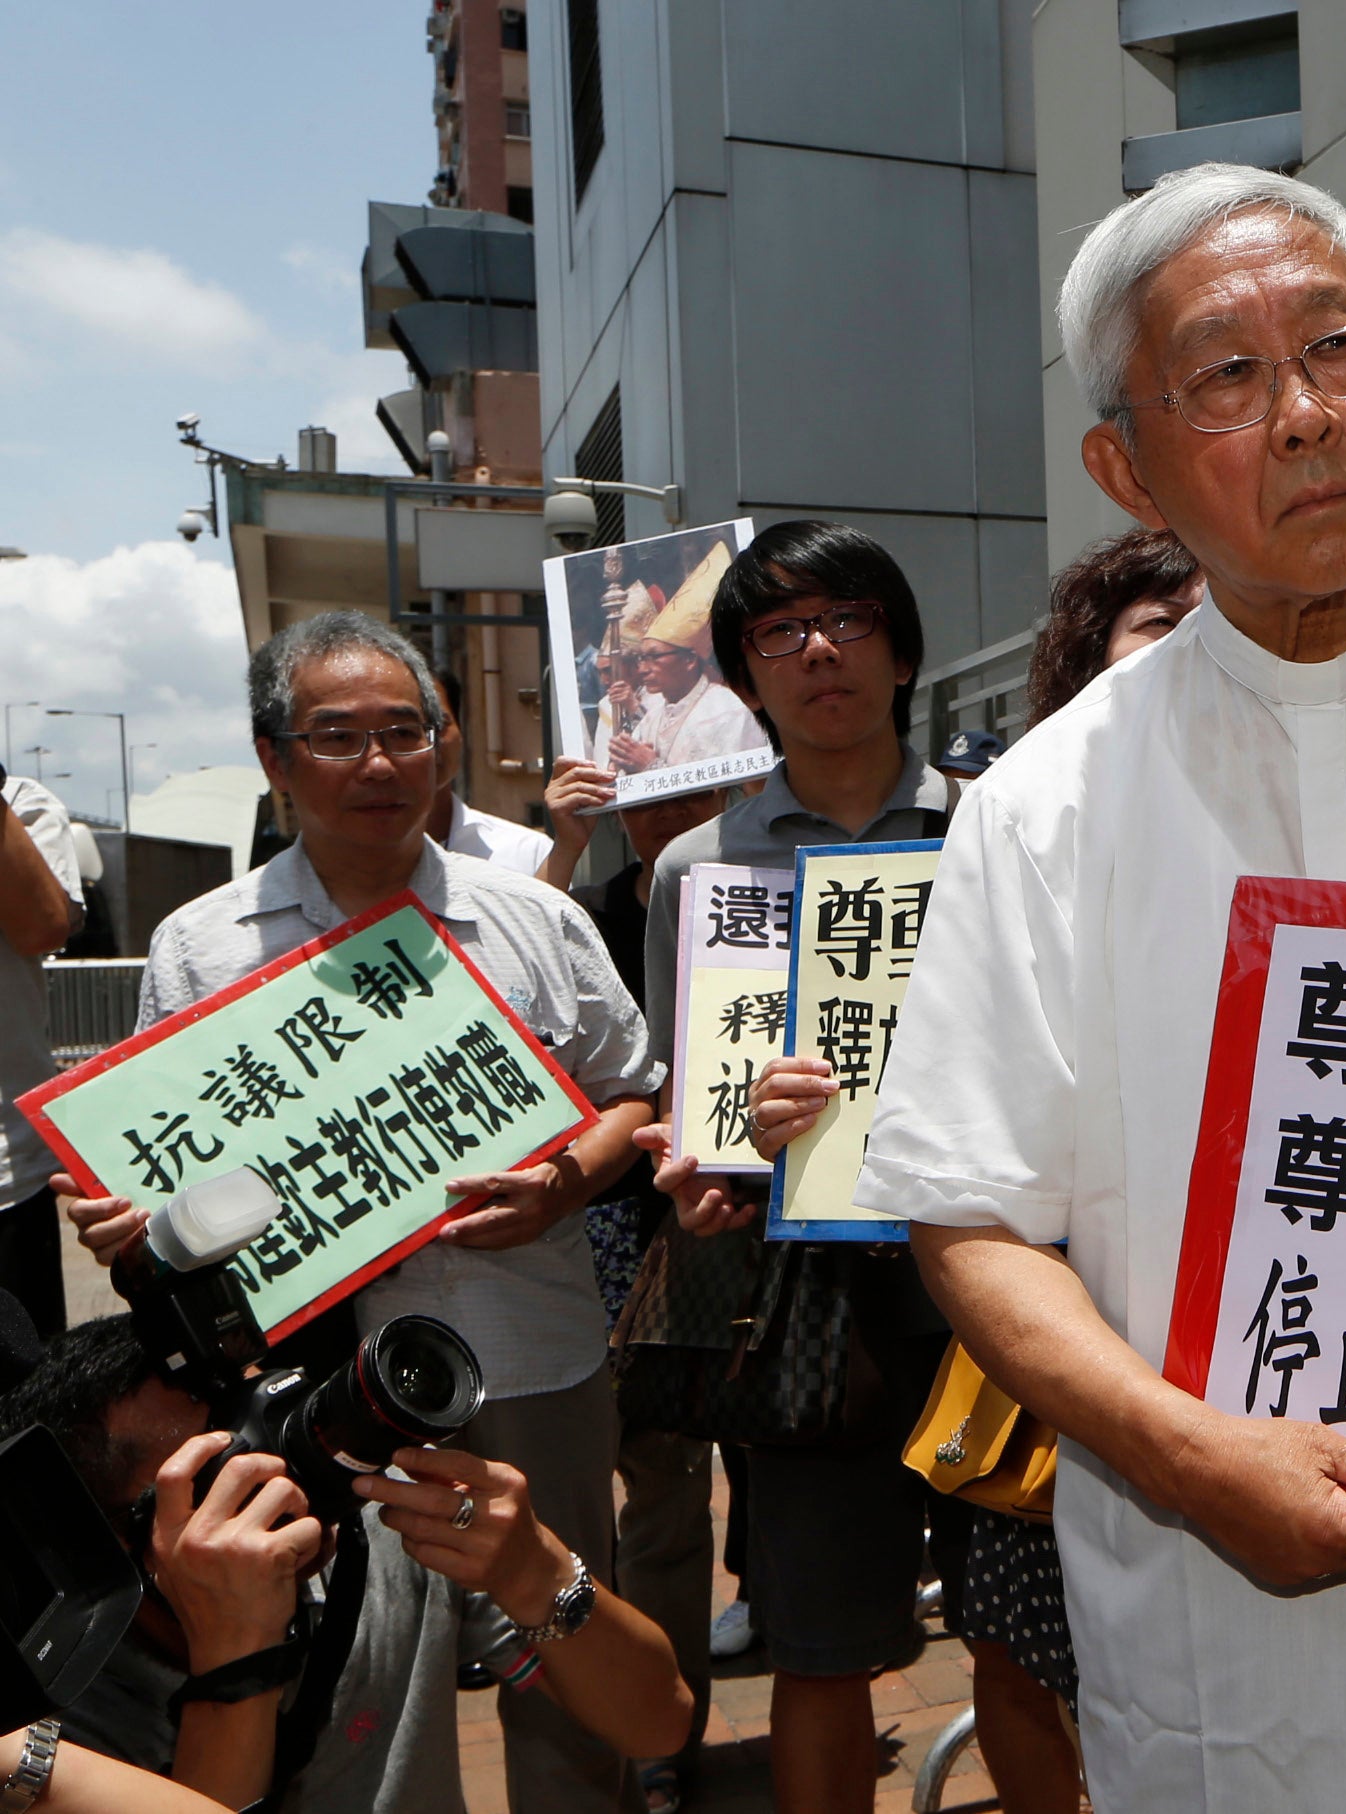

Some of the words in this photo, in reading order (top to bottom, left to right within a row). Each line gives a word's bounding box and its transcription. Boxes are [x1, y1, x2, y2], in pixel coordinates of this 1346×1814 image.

[122, 938, 435, 1194] 抗議限制
[225, 1020, 546, 1294] 欽主教行使牧職
[266, 1373, 302, 1395] Canon
